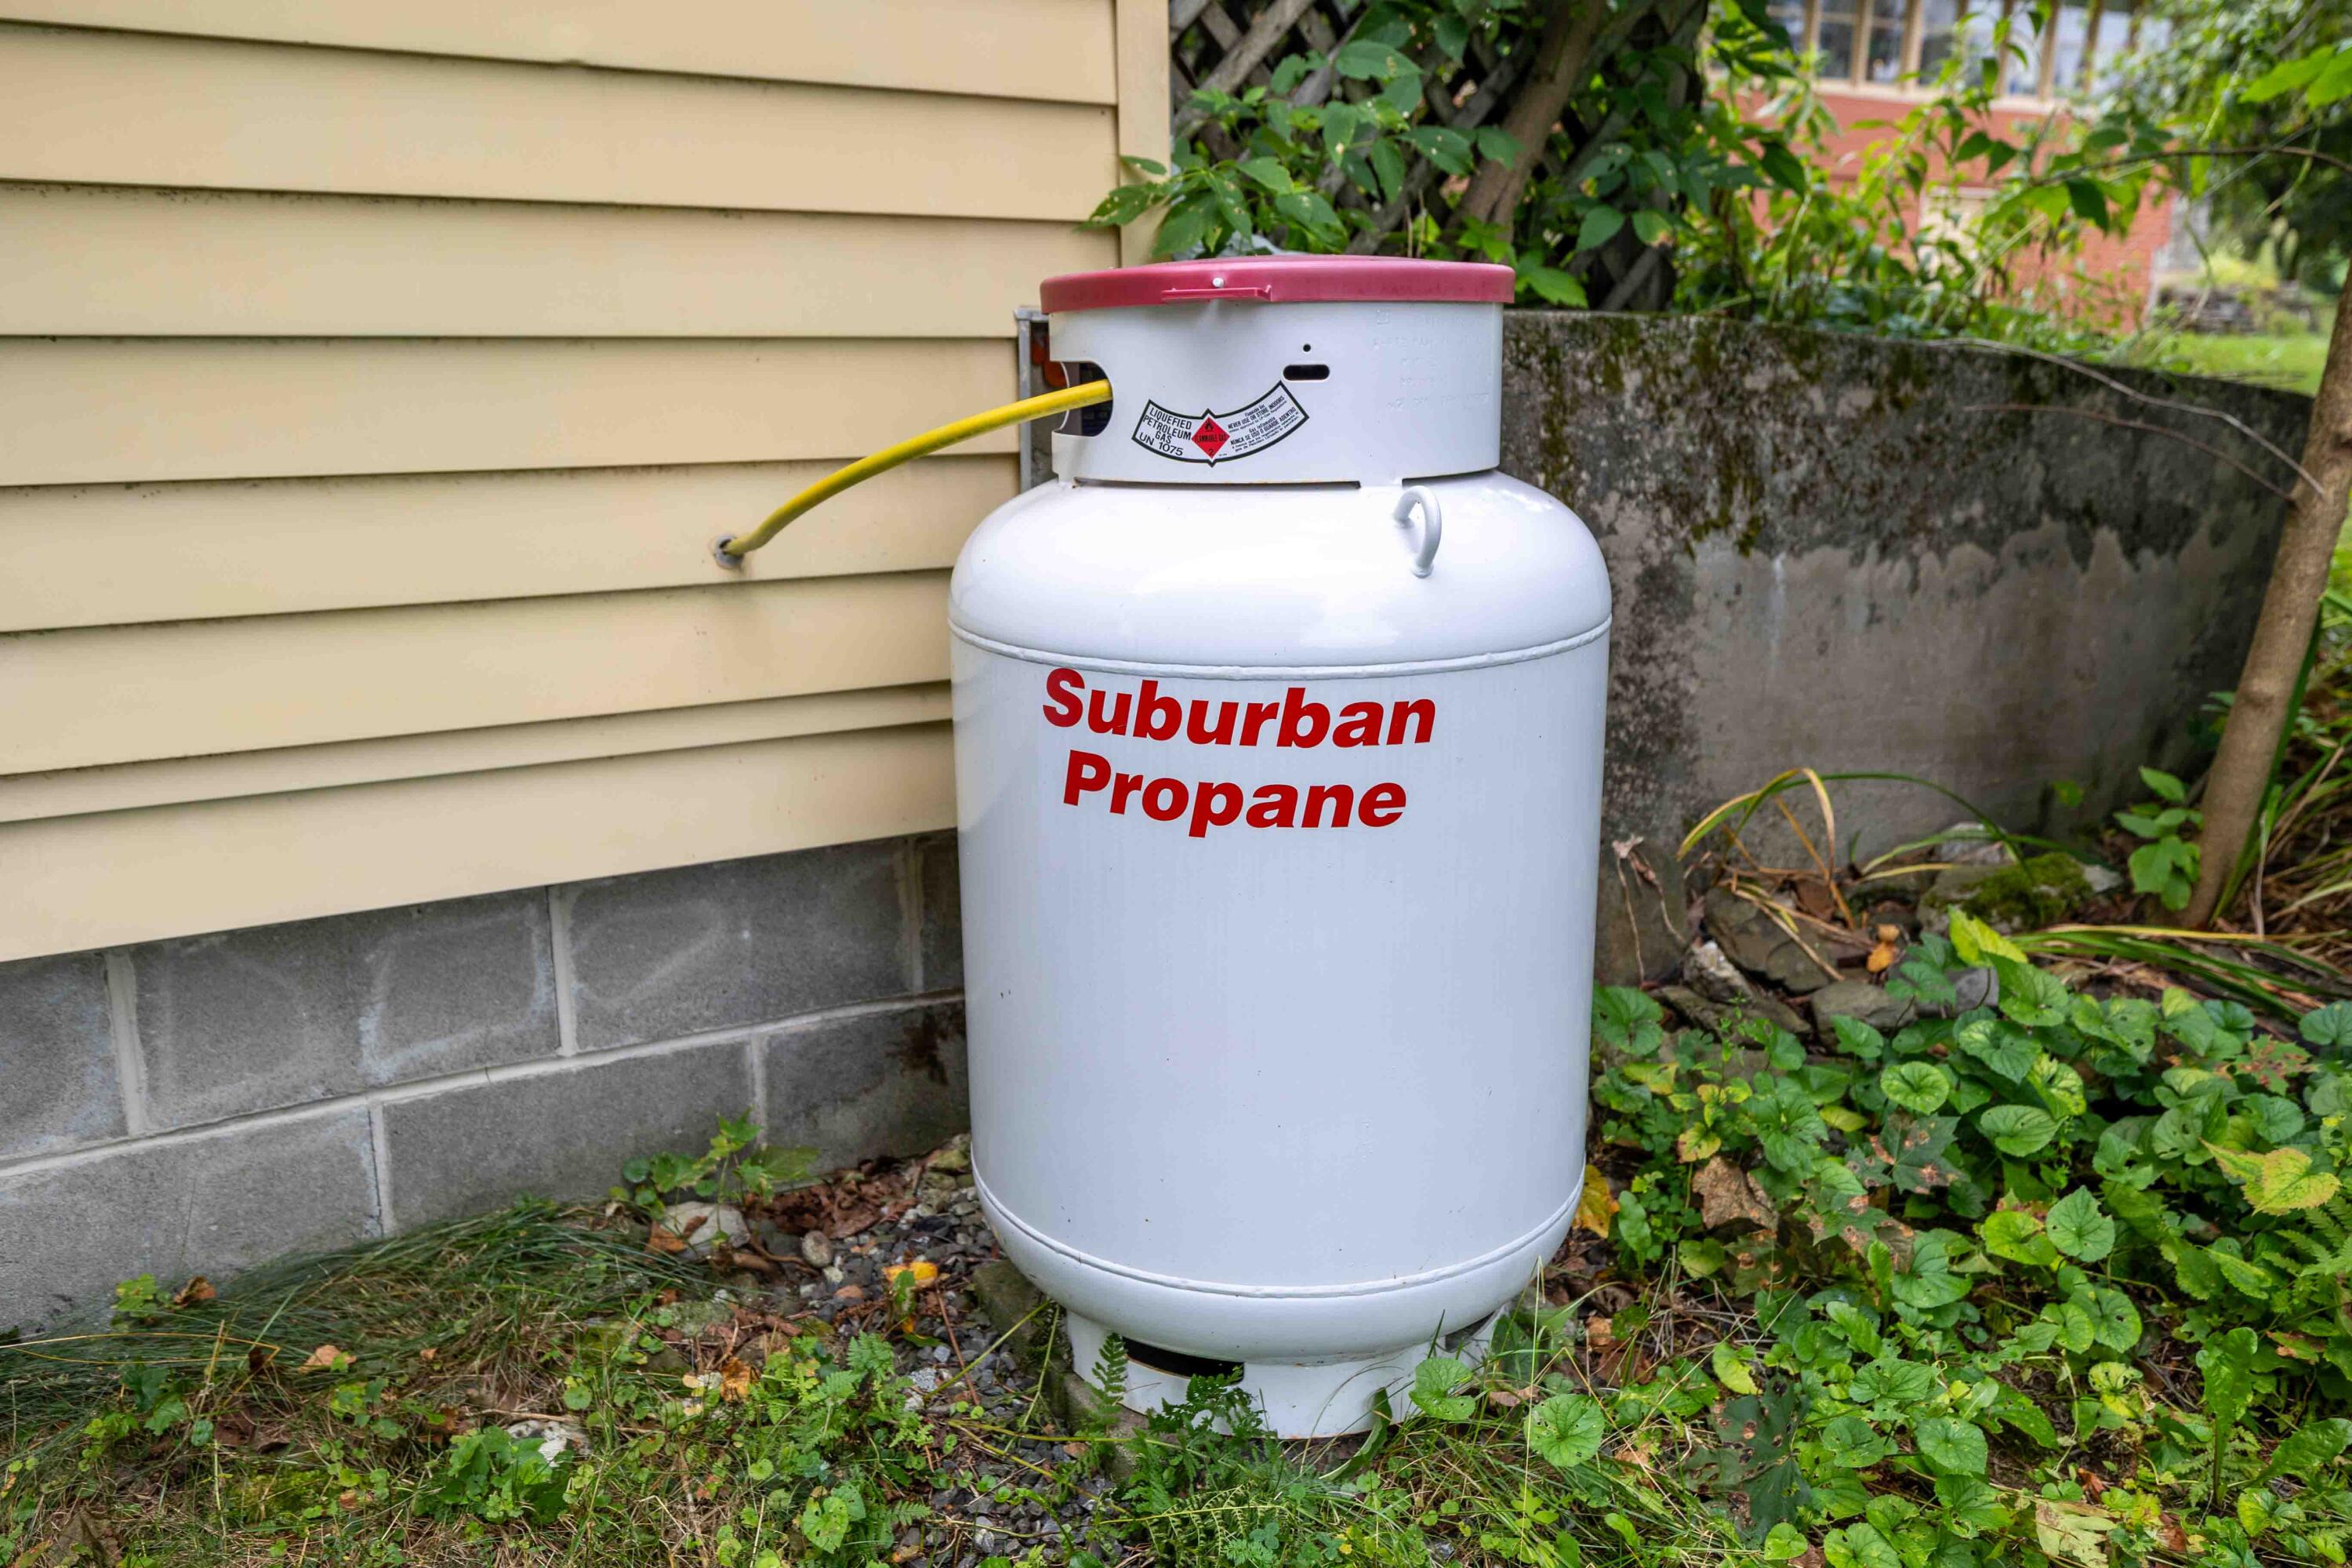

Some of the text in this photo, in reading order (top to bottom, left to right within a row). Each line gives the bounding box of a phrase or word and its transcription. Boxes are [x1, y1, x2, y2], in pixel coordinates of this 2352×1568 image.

[1149, 407, 1192, 430] LIQUEFIED
[1228, 420, 1241, 429] NEVER
[1256, 407, 1269, 417] STORE
[1269, 395, 1285, 409] INDOORS
[1279, 406, 1297, 422] ADENTRO
[1143, 415, 1192, 441] PETROLEUM
[1156, 430, 1172, 444] GAS
[1139, 432, 1184, 456] UN 1075
[1043, 667, 1436, 749] Suburban
[1063, 750, 1406, 838] Propane
